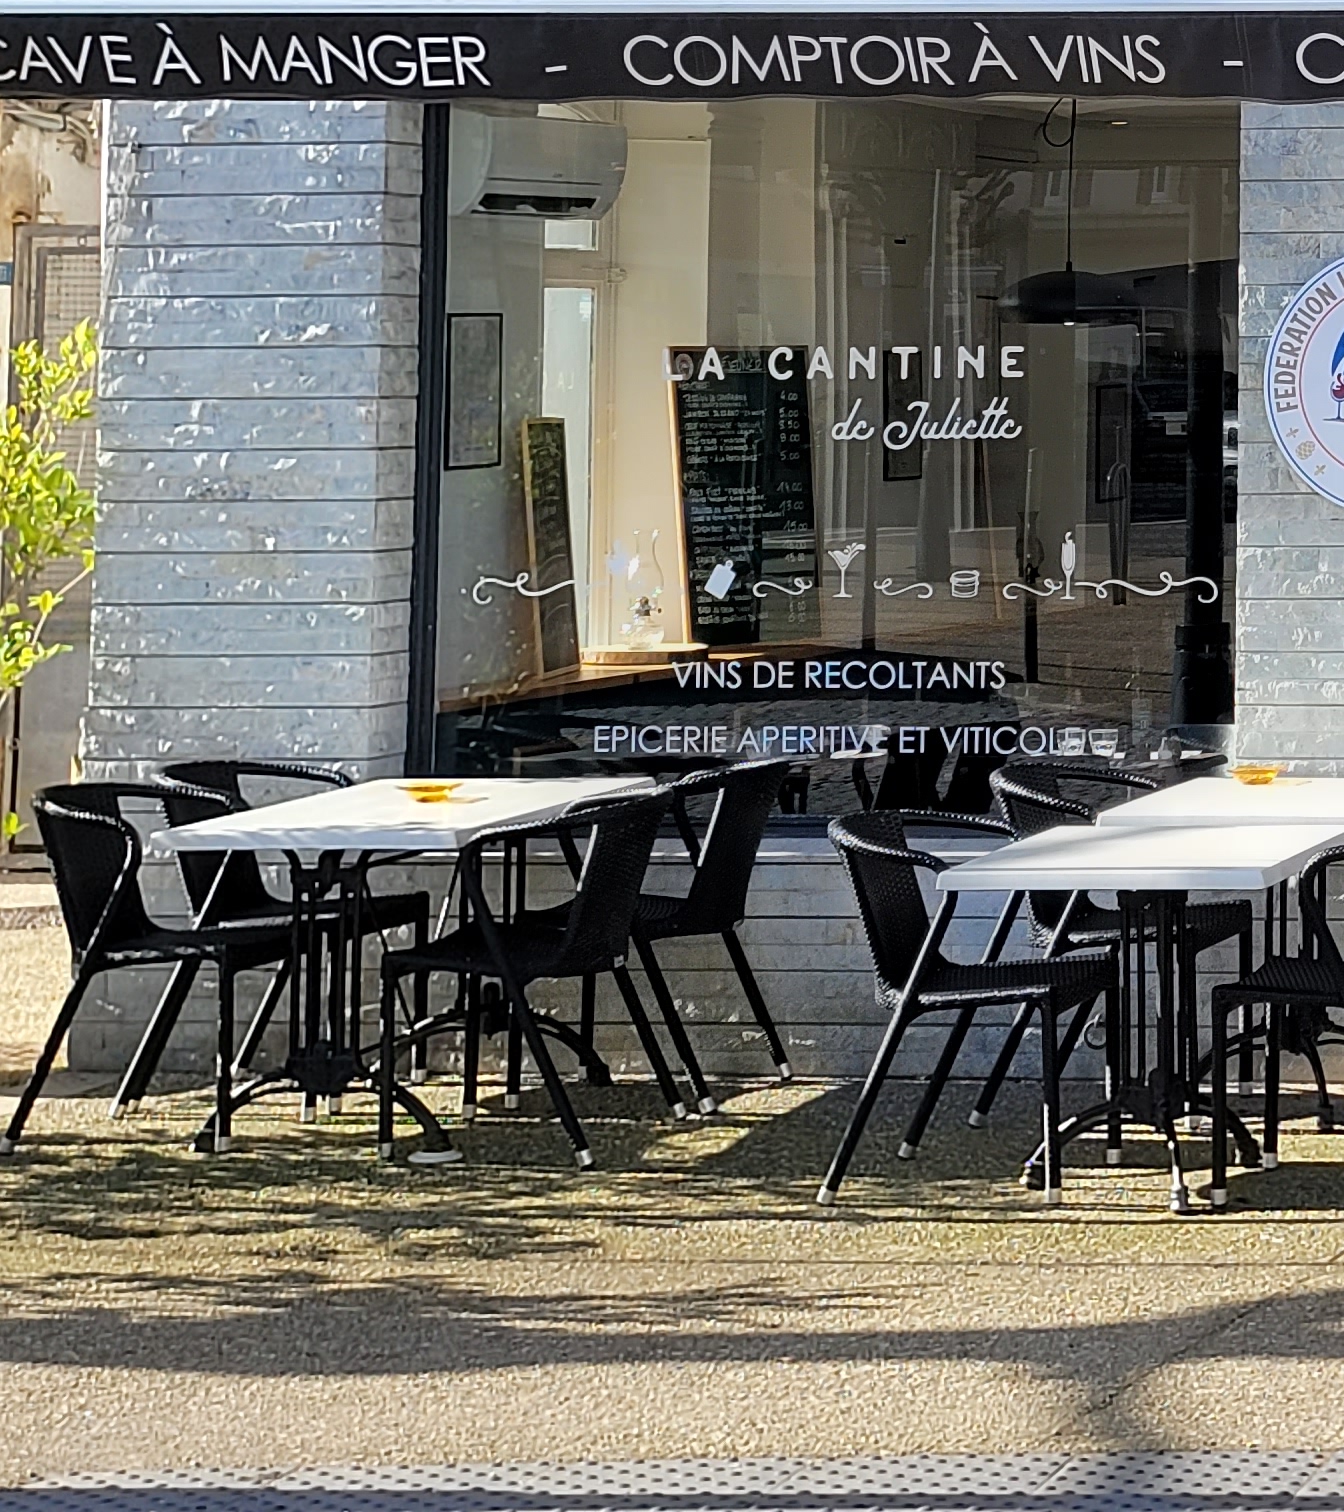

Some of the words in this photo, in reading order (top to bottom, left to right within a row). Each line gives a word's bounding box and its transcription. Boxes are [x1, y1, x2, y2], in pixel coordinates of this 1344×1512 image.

[152, 22, 201, 86] À
[221, 33, 490, 87] MANGER
[623, 34, 956, 86] COMPTOIR
[968, 22, 1017, 82] À
[1028, 34, 1166, 85] VINS
[662, 345, 727, 380] LA
[767, 344, 1026, 380] CANTINE
[1275, 281, 1338, 413] FEDERATION
[831, 396, 874, 441] de
[882, 396, 1023, 451] Juliette
[672, 660, 742, 690] VINS
[753, 662, 795, 689] DE
[805, 660, 1006, 690] RECOLTANTS
[593, 725, 728, 754] EPICERIE
[735, 725, 890, 754] APERITIVE
[899, 725, 931, 754] ET
